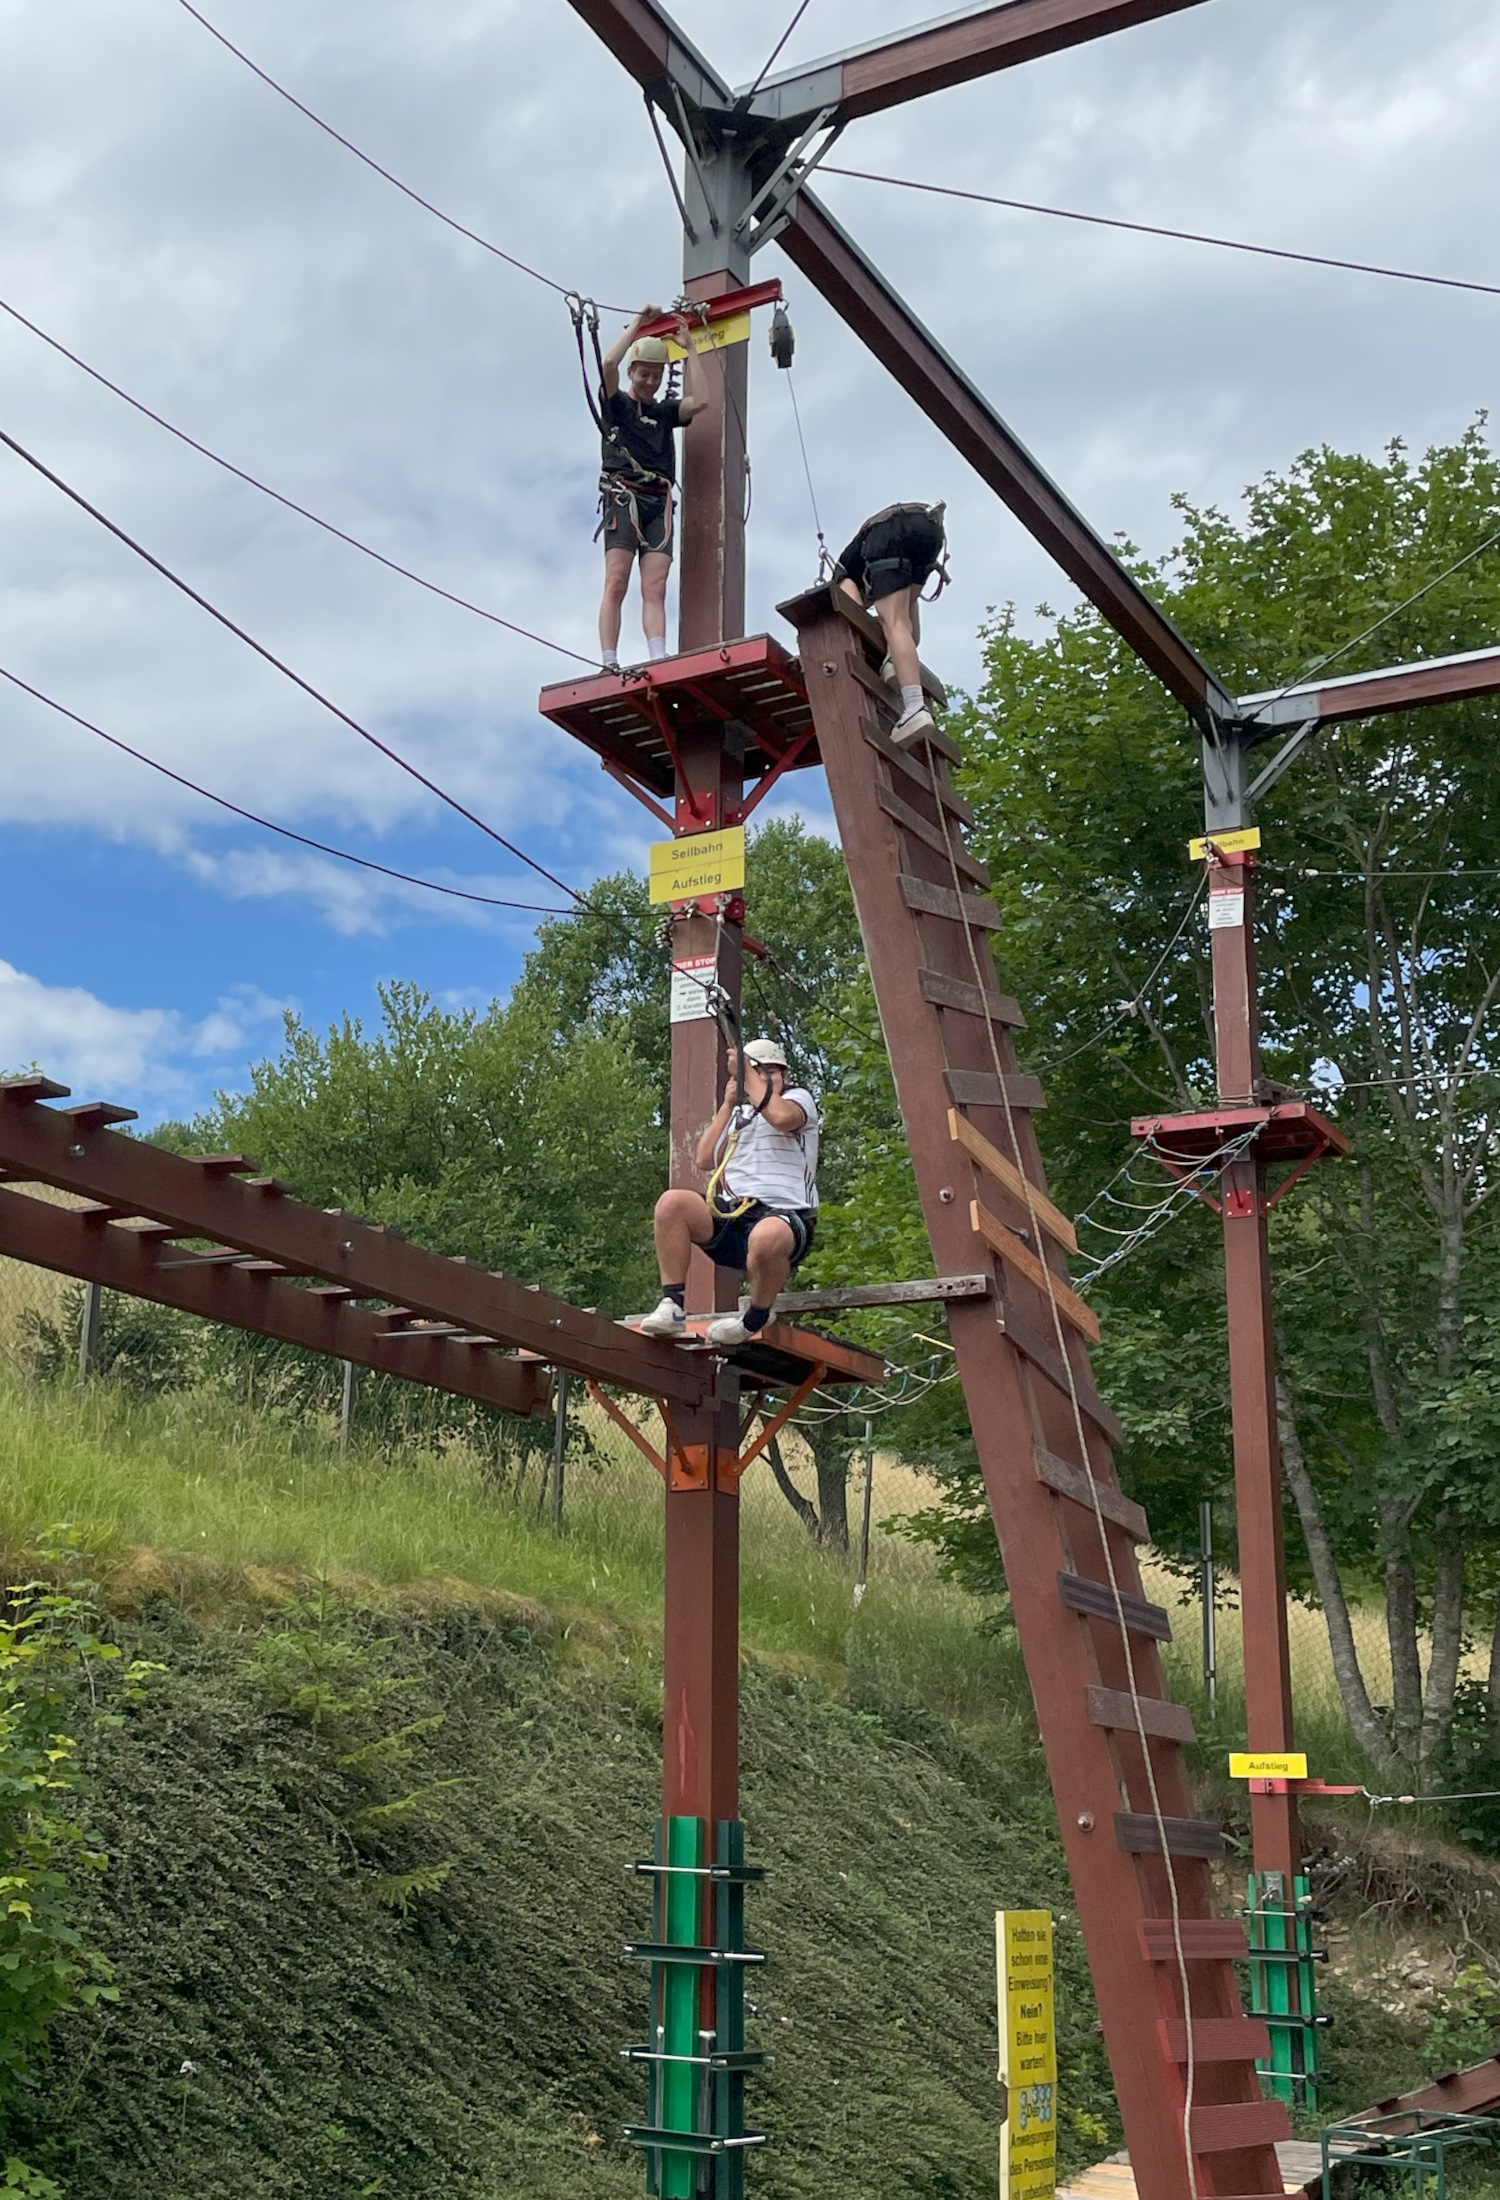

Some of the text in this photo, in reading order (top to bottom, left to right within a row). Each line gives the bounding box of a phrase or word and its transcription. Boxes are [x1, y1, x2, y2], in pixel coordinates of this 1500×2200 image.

[671, 842, 723, 860] Seilbahn
[671, 873, 722, 891] Aufstieg
[1248, 1761, 1289, 1772] Aufstieg
[1011, 1927, 1047, 1943] Hatten sie
[1011, 1952, 1049, 1967] schon eine
[1008, 1973, 1052, 1993] Einweisung?
[1020, 2002, 1043, 2020] Nein?
[1016, 2030, 1048, 2047] Bitte hier
[1020, 2053, 1047, 2071] warten!
[1010, 2129, 1055, 2149] Anweisungen
[1010, 2155, 1055, 2177] des Personals
